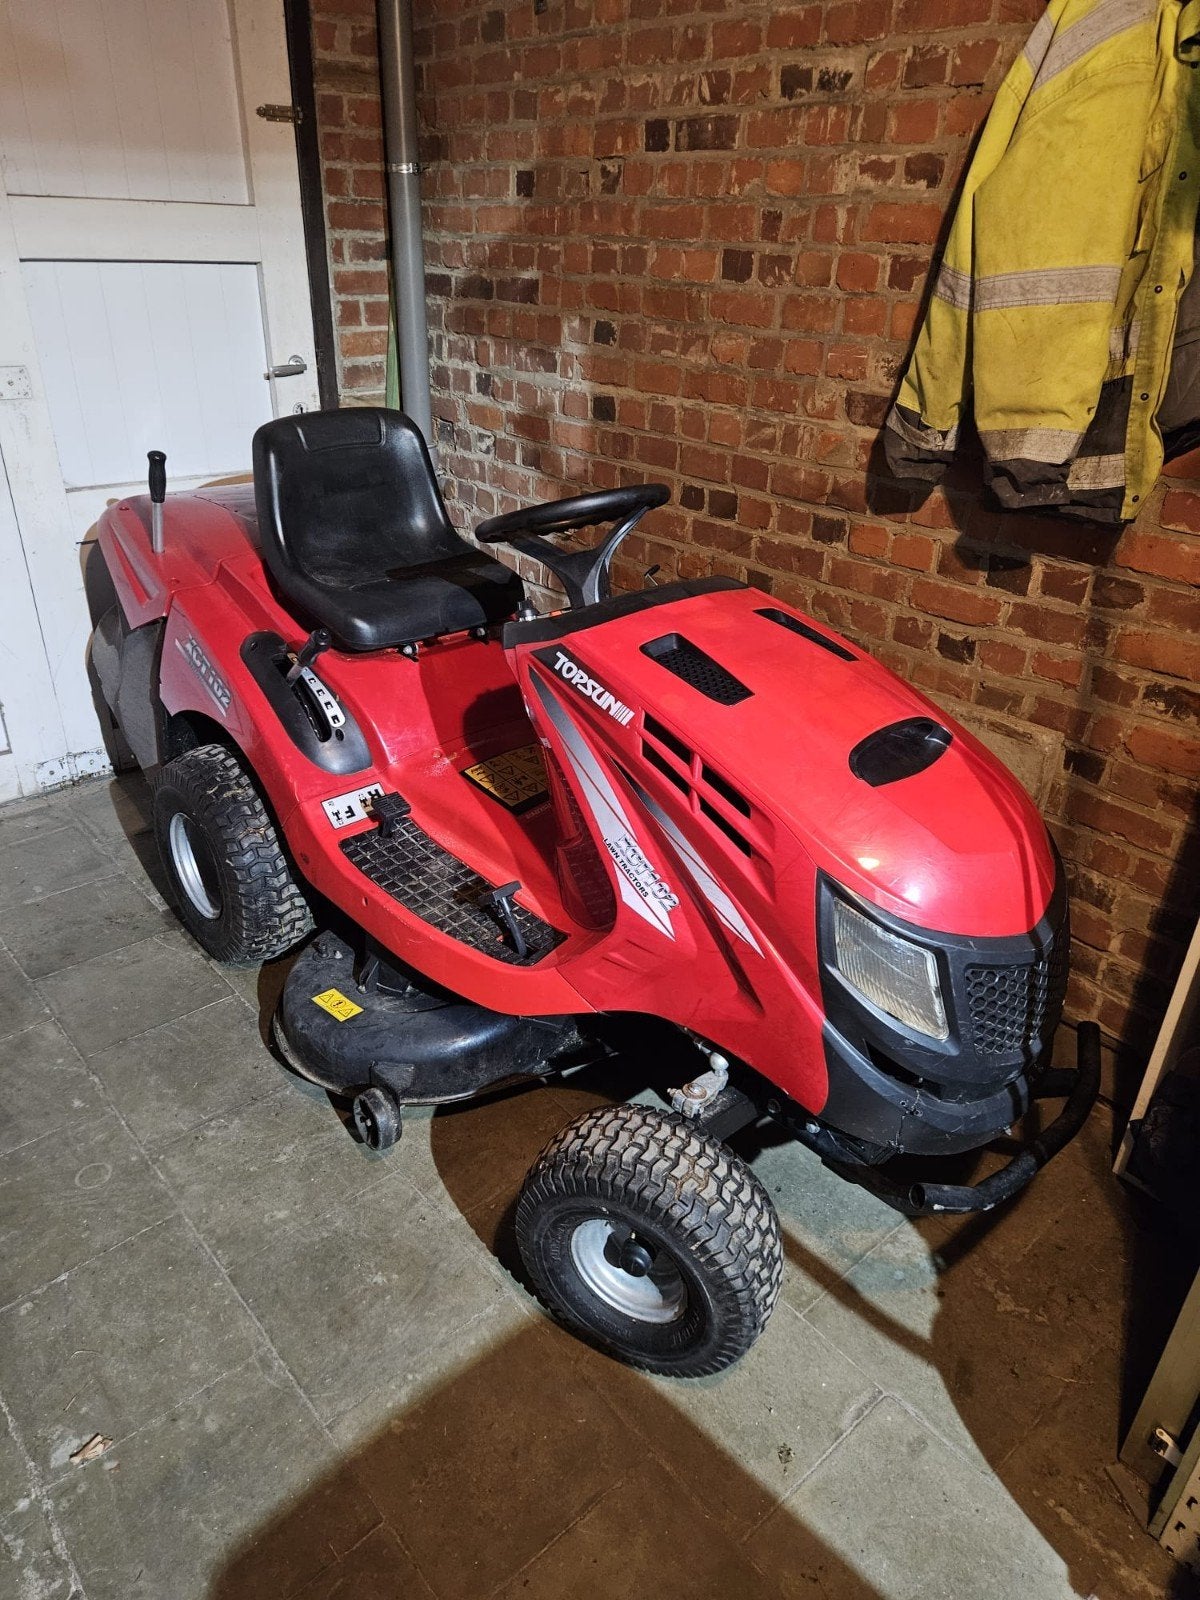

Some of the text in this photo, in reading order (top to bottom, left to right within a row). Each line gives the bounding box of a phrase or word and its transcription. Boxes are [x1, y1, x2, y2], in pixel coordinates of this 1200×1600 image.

[554, 651, 635, 726] TOPSUN
[603, 838, 649, 898] LAWN TRACTORS
